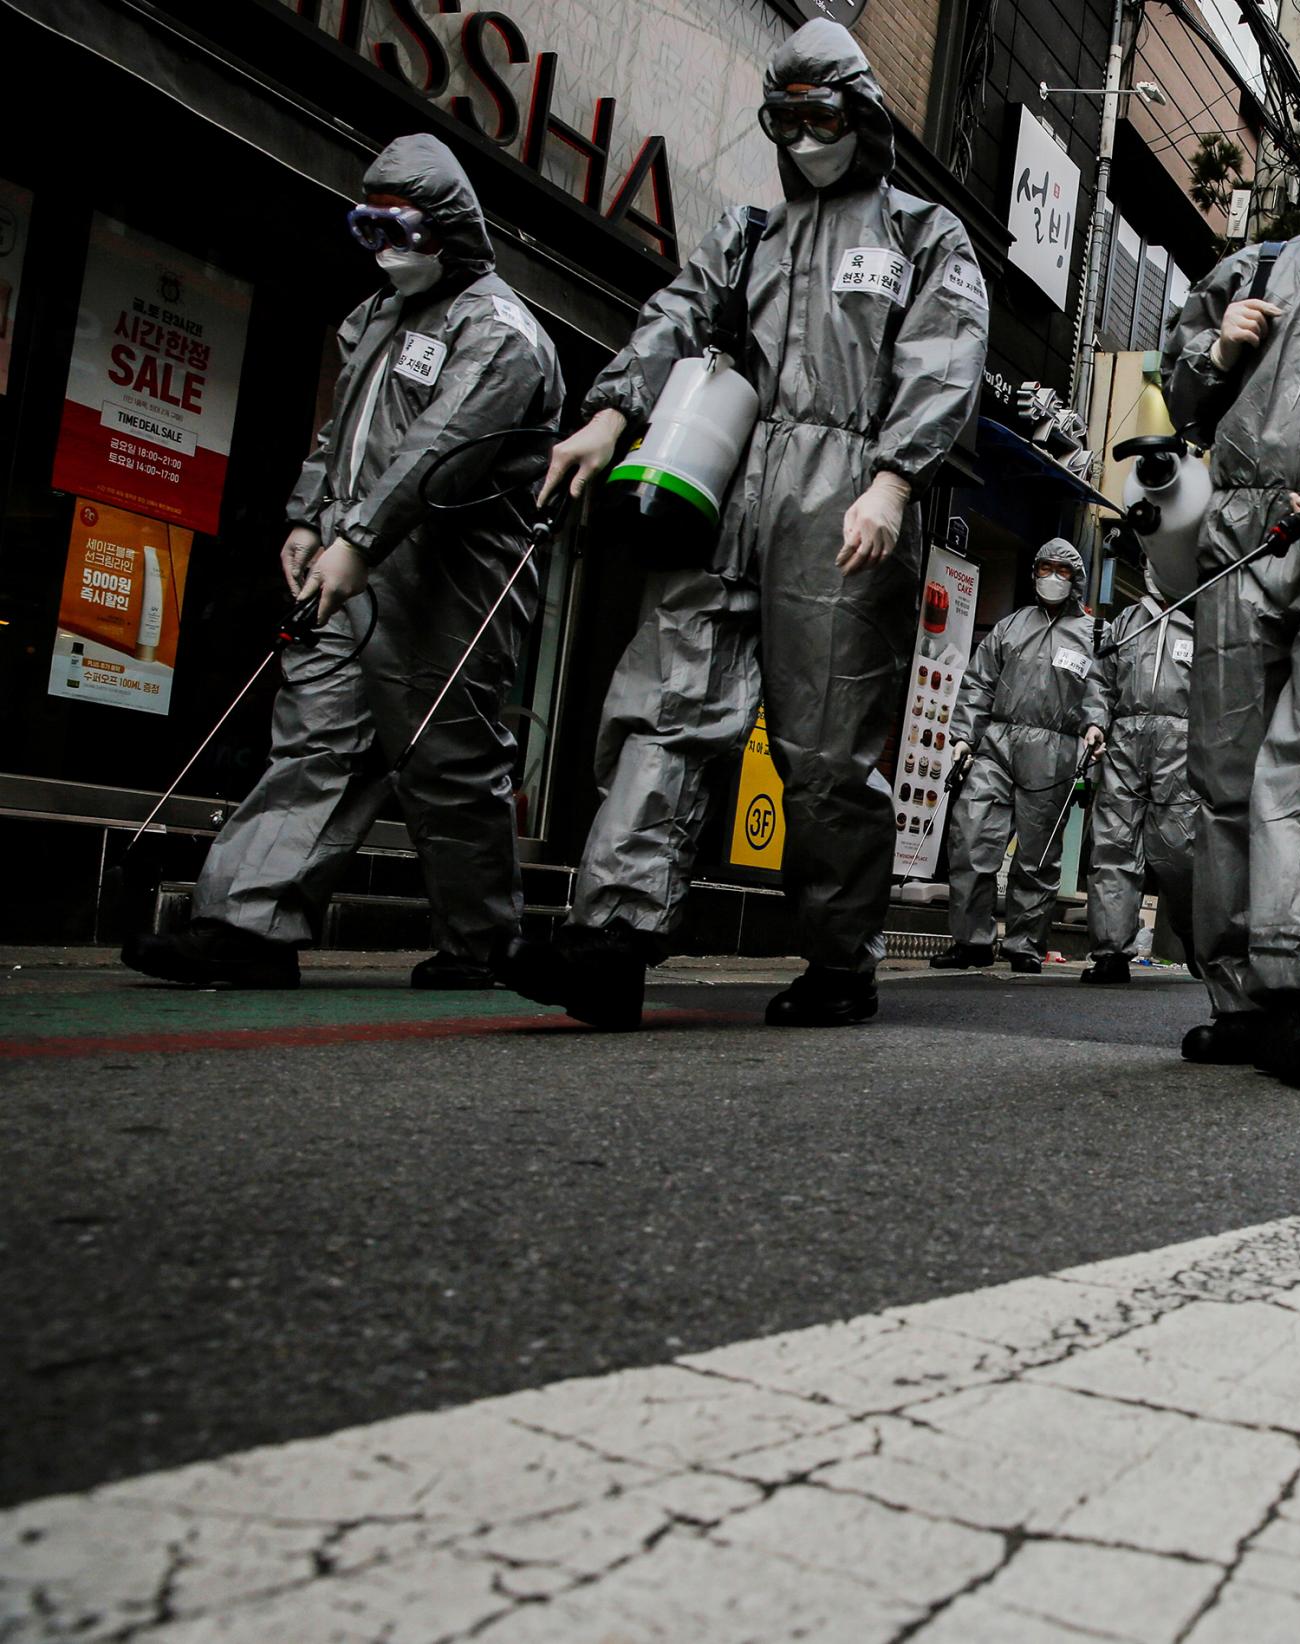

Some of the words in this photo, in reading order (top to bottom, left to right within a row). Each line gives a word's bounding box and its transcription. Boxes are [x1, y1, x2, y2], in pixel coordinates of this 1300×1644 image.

[851, 254, 864, 269] 육
[890, 260, 904, 279] 군
[842, 271, 864, 285] 현장
[867, 273, 902, 296] 지원팀
[422, 346, 435, 361] 군
[108, 344, 206, 415] SALE
[406, 358, 432, 377] 지원팀
[118, 411, 138, 428] TIME
[139, 418, 160, 436] DEAL
[161, 427, 183, 444] SALE
[110, 437, 136, 456] 금요일
[138, 446, 182, 471] 18:00~21:00
[108, 452, 135, 470] 토요일
[136, 460, 180, 484] 14:00~17:00
[84, 550, 134, 573] 선크림라인
[82, 567, 132, 596] 5,000원
[946, 566, 975, 587] TWOSOME
[80, 586, 130, 612] 즉시할인
[957, 583, 973, 597] CAKE
[83, 670, 118, 686] 수퍼오프
[119, 677, 141, 691] 100ML
[143, 682, 160, 694] 증정
[750, 808, 772, 838] 3F
